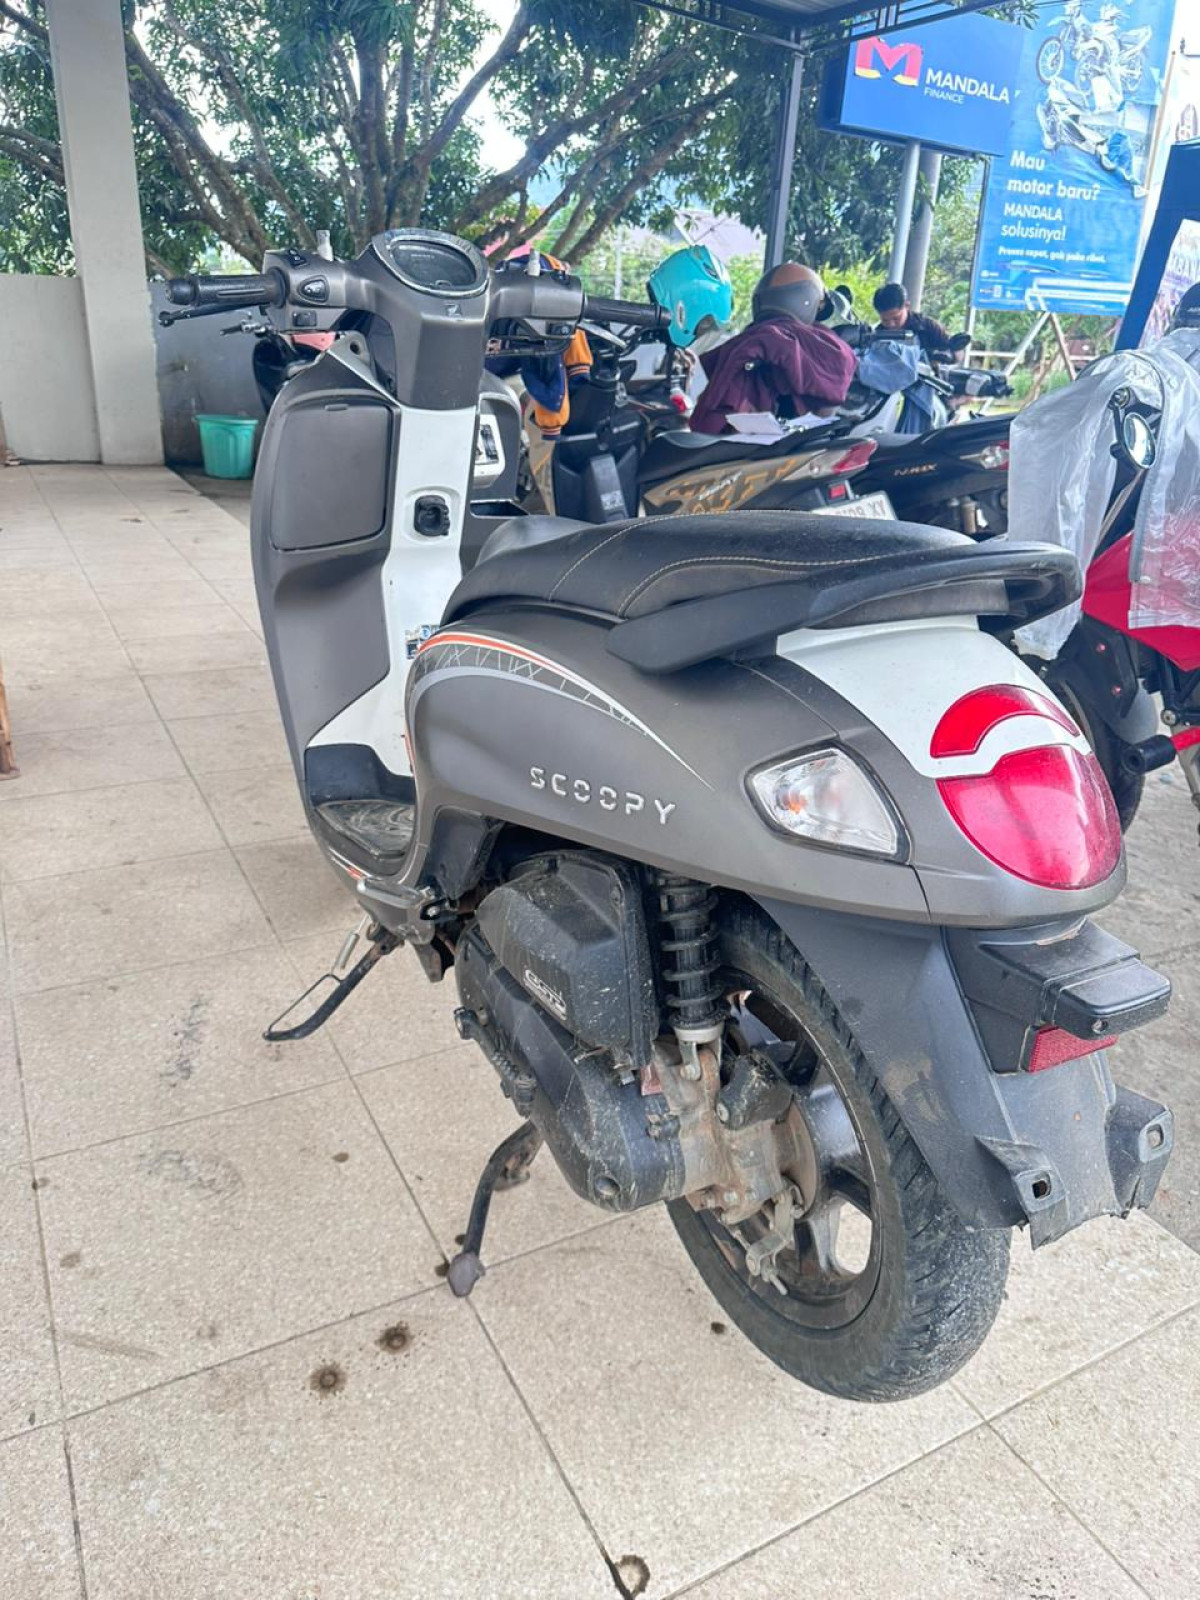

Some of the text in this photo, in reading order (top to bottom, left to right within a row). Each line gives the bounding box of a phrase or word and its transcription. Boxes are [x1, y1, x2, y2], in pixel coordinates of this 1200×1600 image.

[924, 87, 965, 104] FINANCE
[925, 67, 1010, 104] MANDALA
[1009, 149, 1045, 171] Mau
[1007, 179, 1101, 201] motor baru?
[1004, 202, 1063, 221] MANDALA
[1000, 220, 1067, 244] solusinya!
[530, 766, 676, 825] SCOOPY
